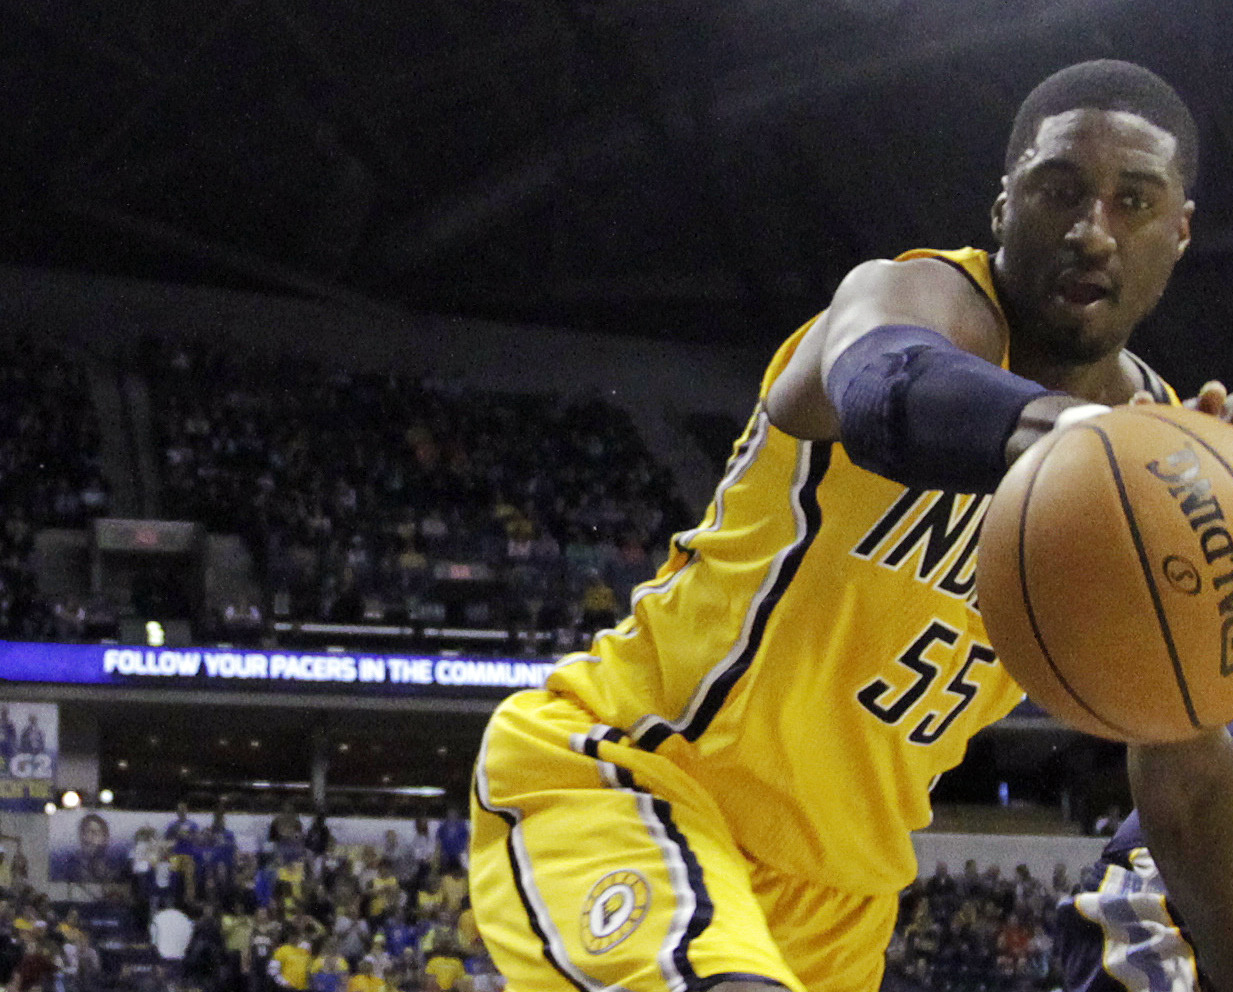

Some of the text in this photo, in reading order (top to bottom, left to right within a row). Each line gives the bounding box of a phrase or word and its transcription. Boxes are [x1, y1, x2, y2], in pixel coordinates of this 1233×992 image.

[849, 487, 992, 616] IND
[103, 649, 200, 676] FOLLOW
[203, 652, 268, 679] YOUR
[270, 654, 358, 683] PACERS
[358, 657, 384, 683] IN
[386, 658, 433, 685] THE
[856, 617, 999, 747] 55
[10, 753, 52, 778] G2
